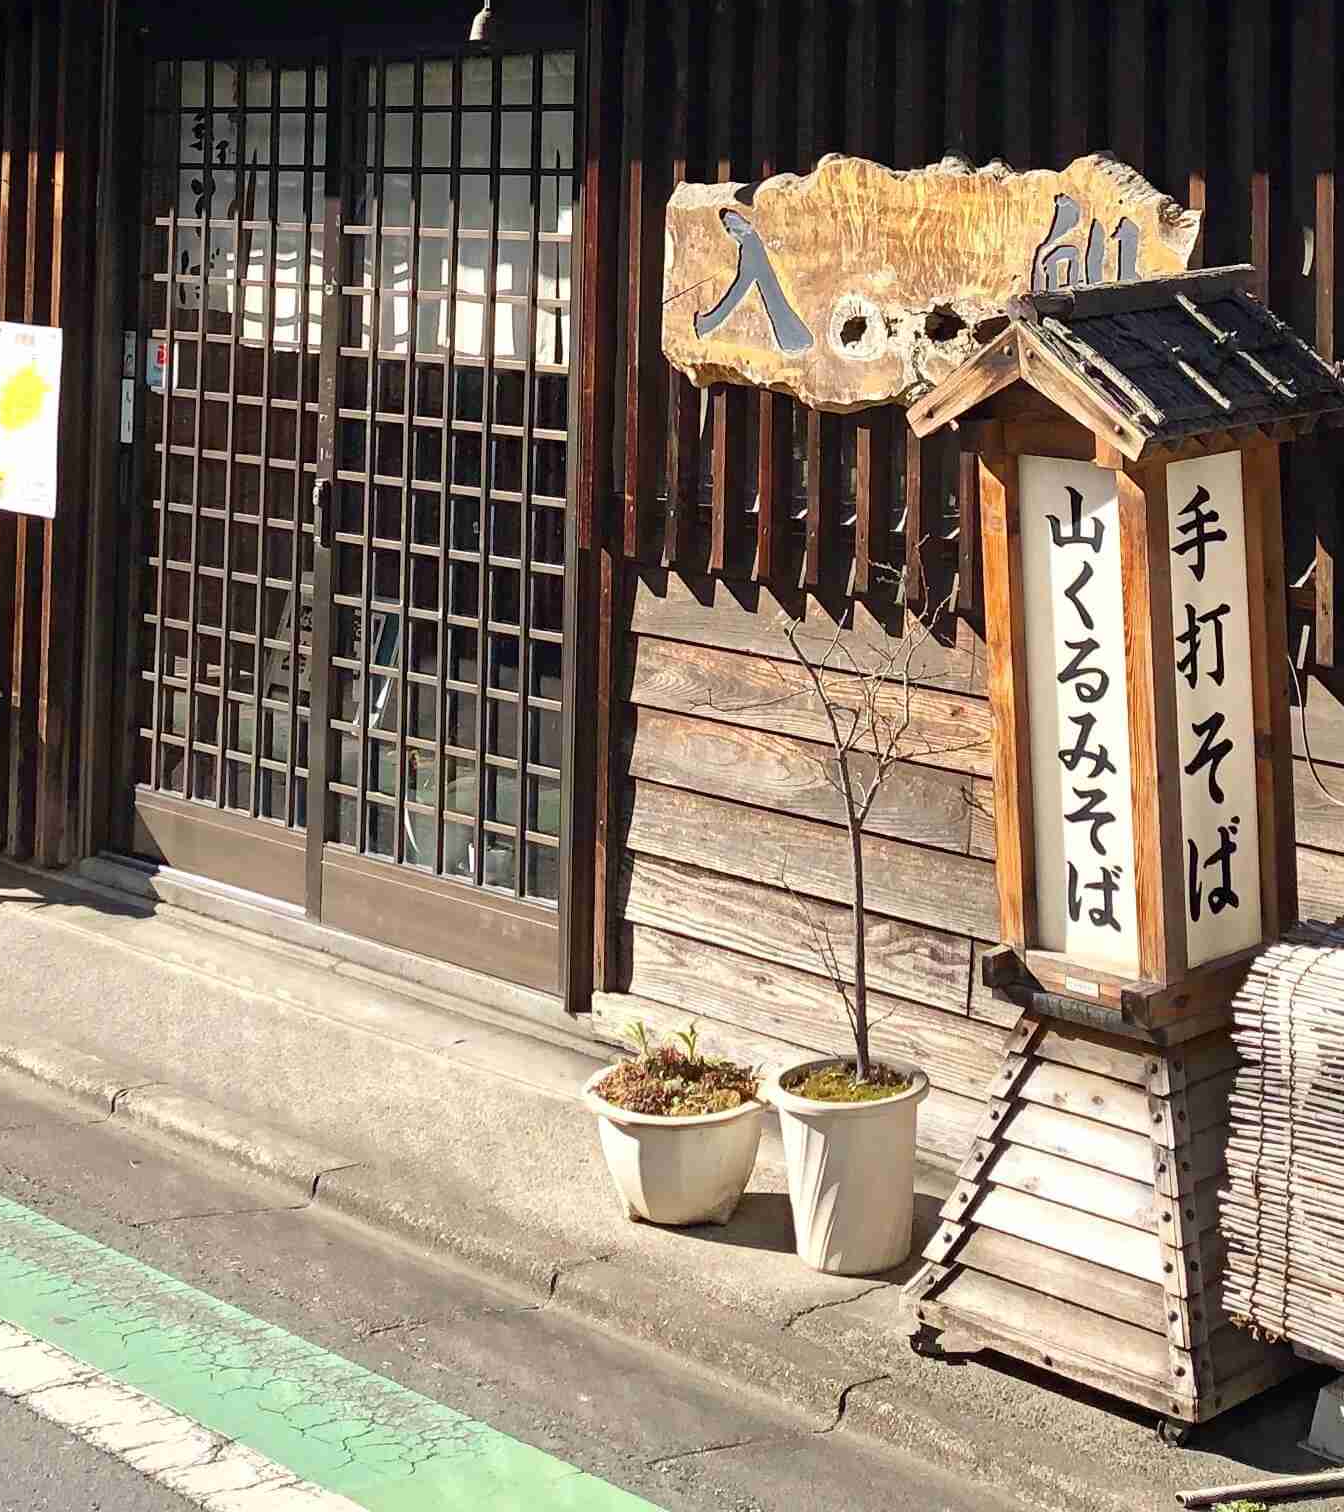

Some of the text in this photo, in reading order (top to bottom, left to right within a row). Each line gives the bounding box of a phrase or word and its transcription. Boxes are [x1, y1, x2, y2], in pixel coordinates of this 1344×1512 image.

[1044, 484, 1123, 934] 山くるみそば
[1170, 483, 1240, 924] 手打そば
